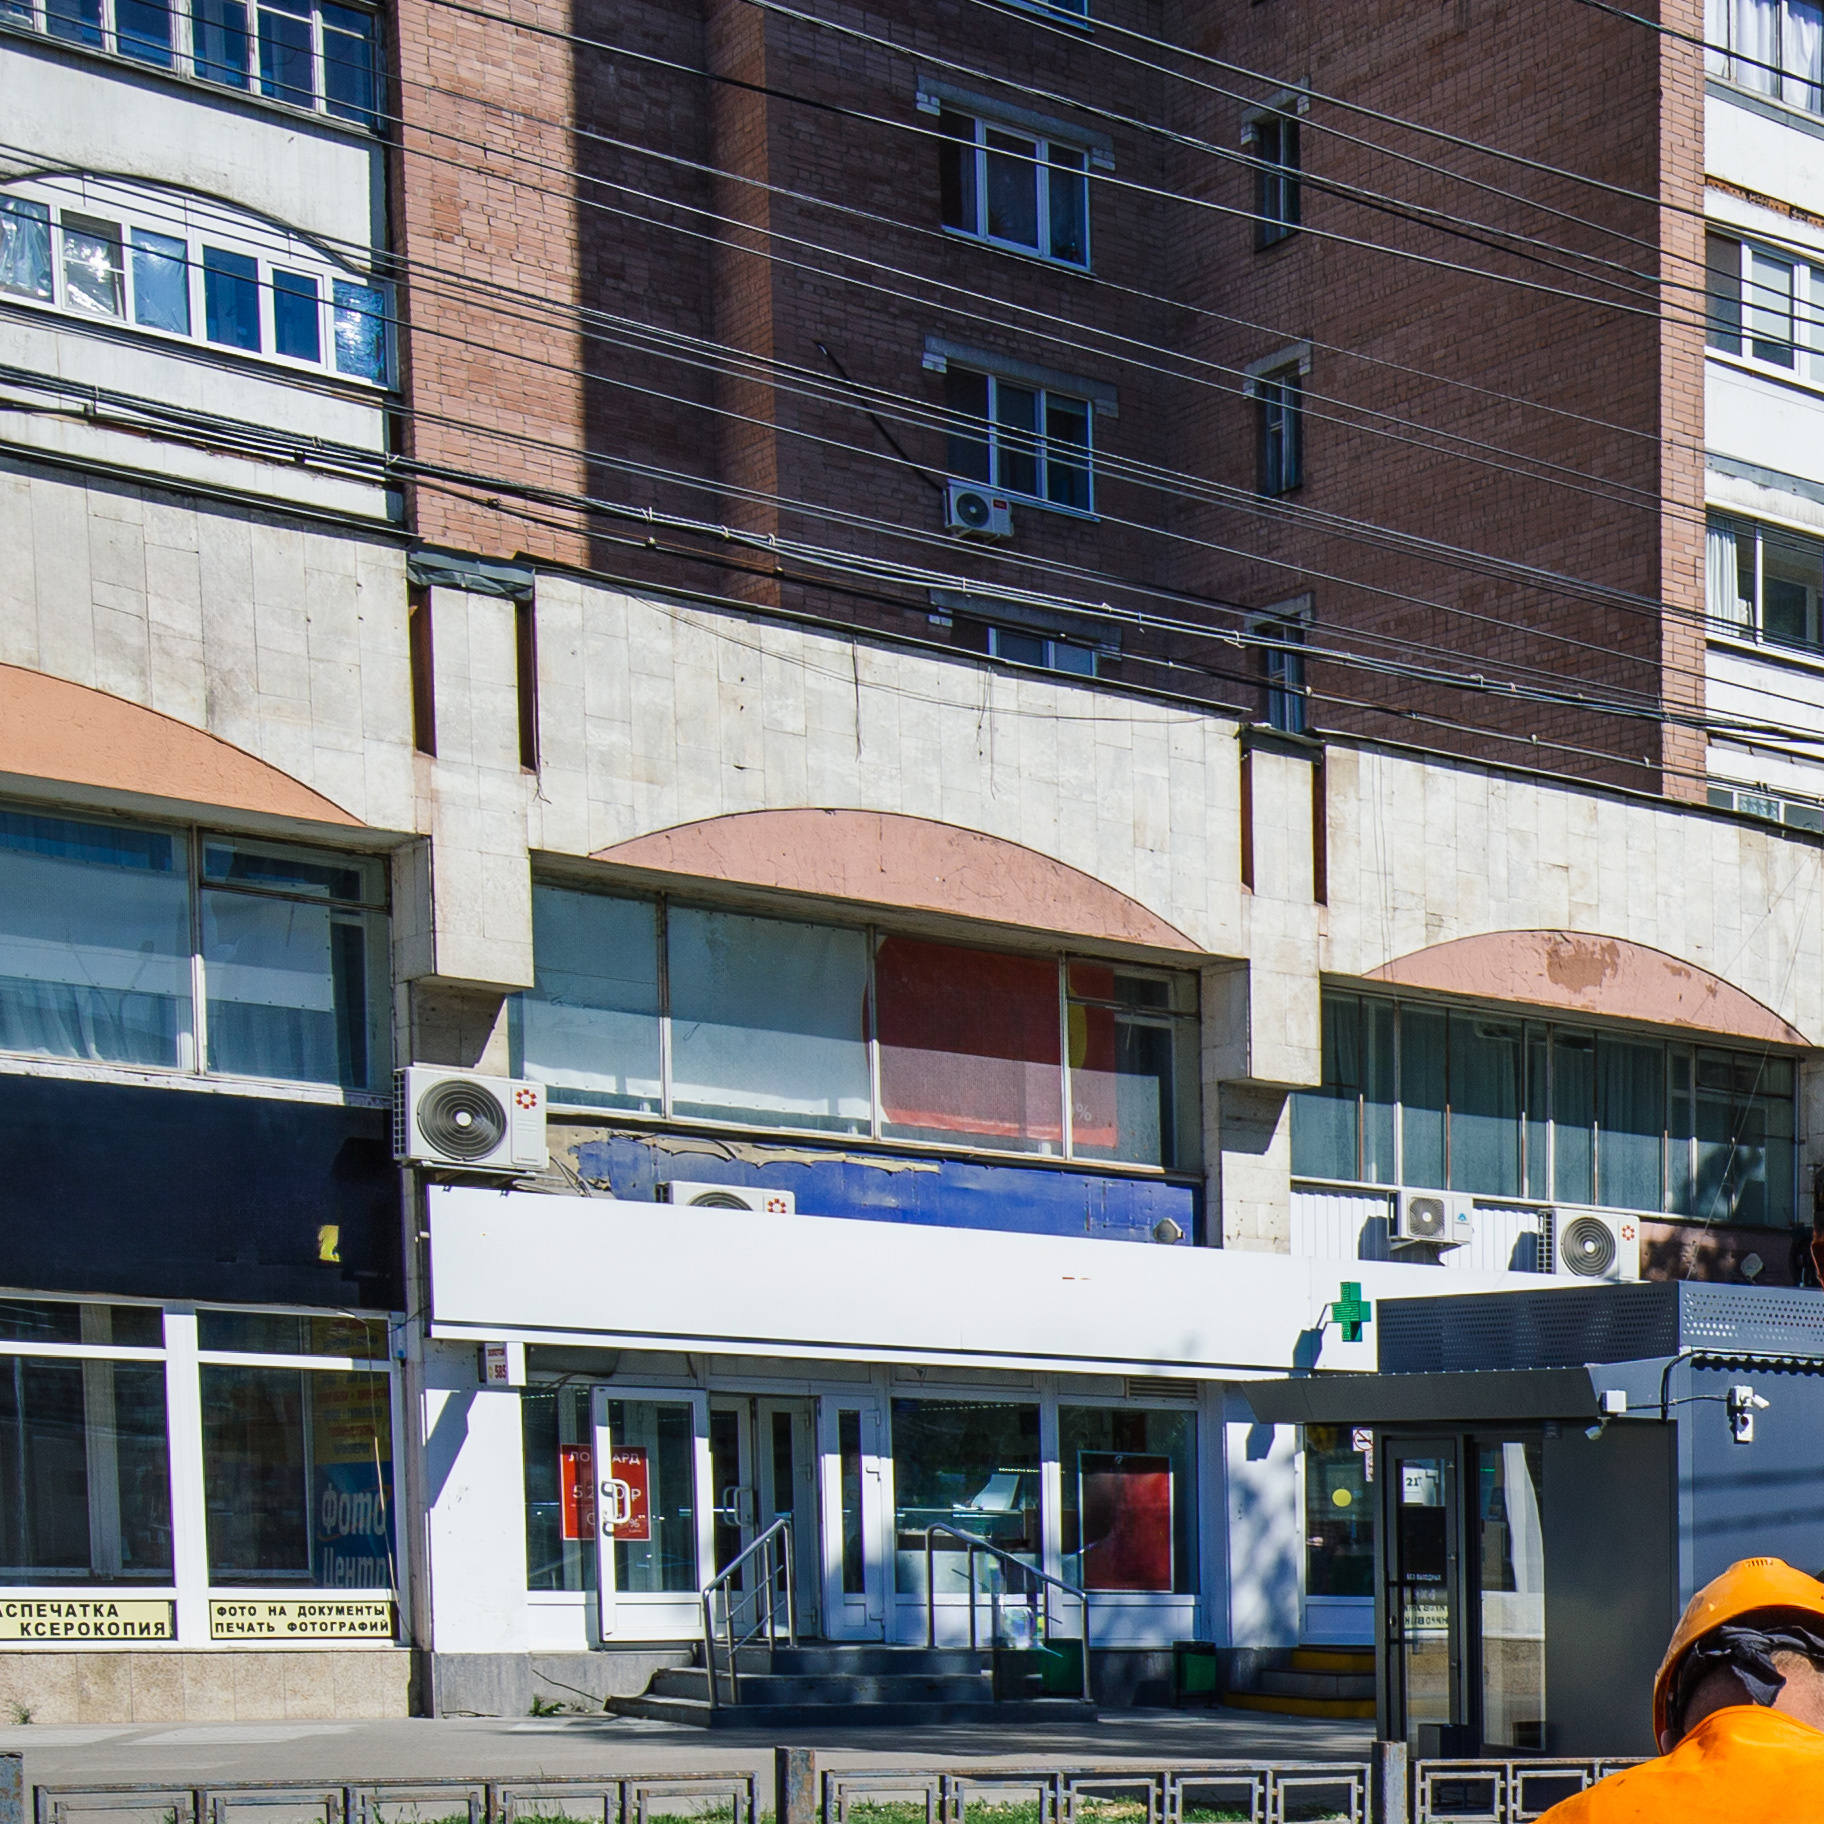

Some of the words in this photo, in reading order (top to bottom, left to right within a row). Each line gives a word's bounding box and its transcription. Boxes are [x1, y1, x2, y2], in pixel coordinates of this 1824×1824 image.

[569, 1451, 641, 1465] ЛОАРД
[216, 1606, 257, 1617] ФОТО
[268, 1606, 287, 1616] НА
[297, 1605, 385, 1618] ДОКУМЕНТЫ
[20, 1622, 165, 1636] КСЕРОКОПИЯ
[215, 1621, 276, 1633] ПЕЧАТЬ
[287, 1619, 389, 1633] ФОТОГРАФИЙ
